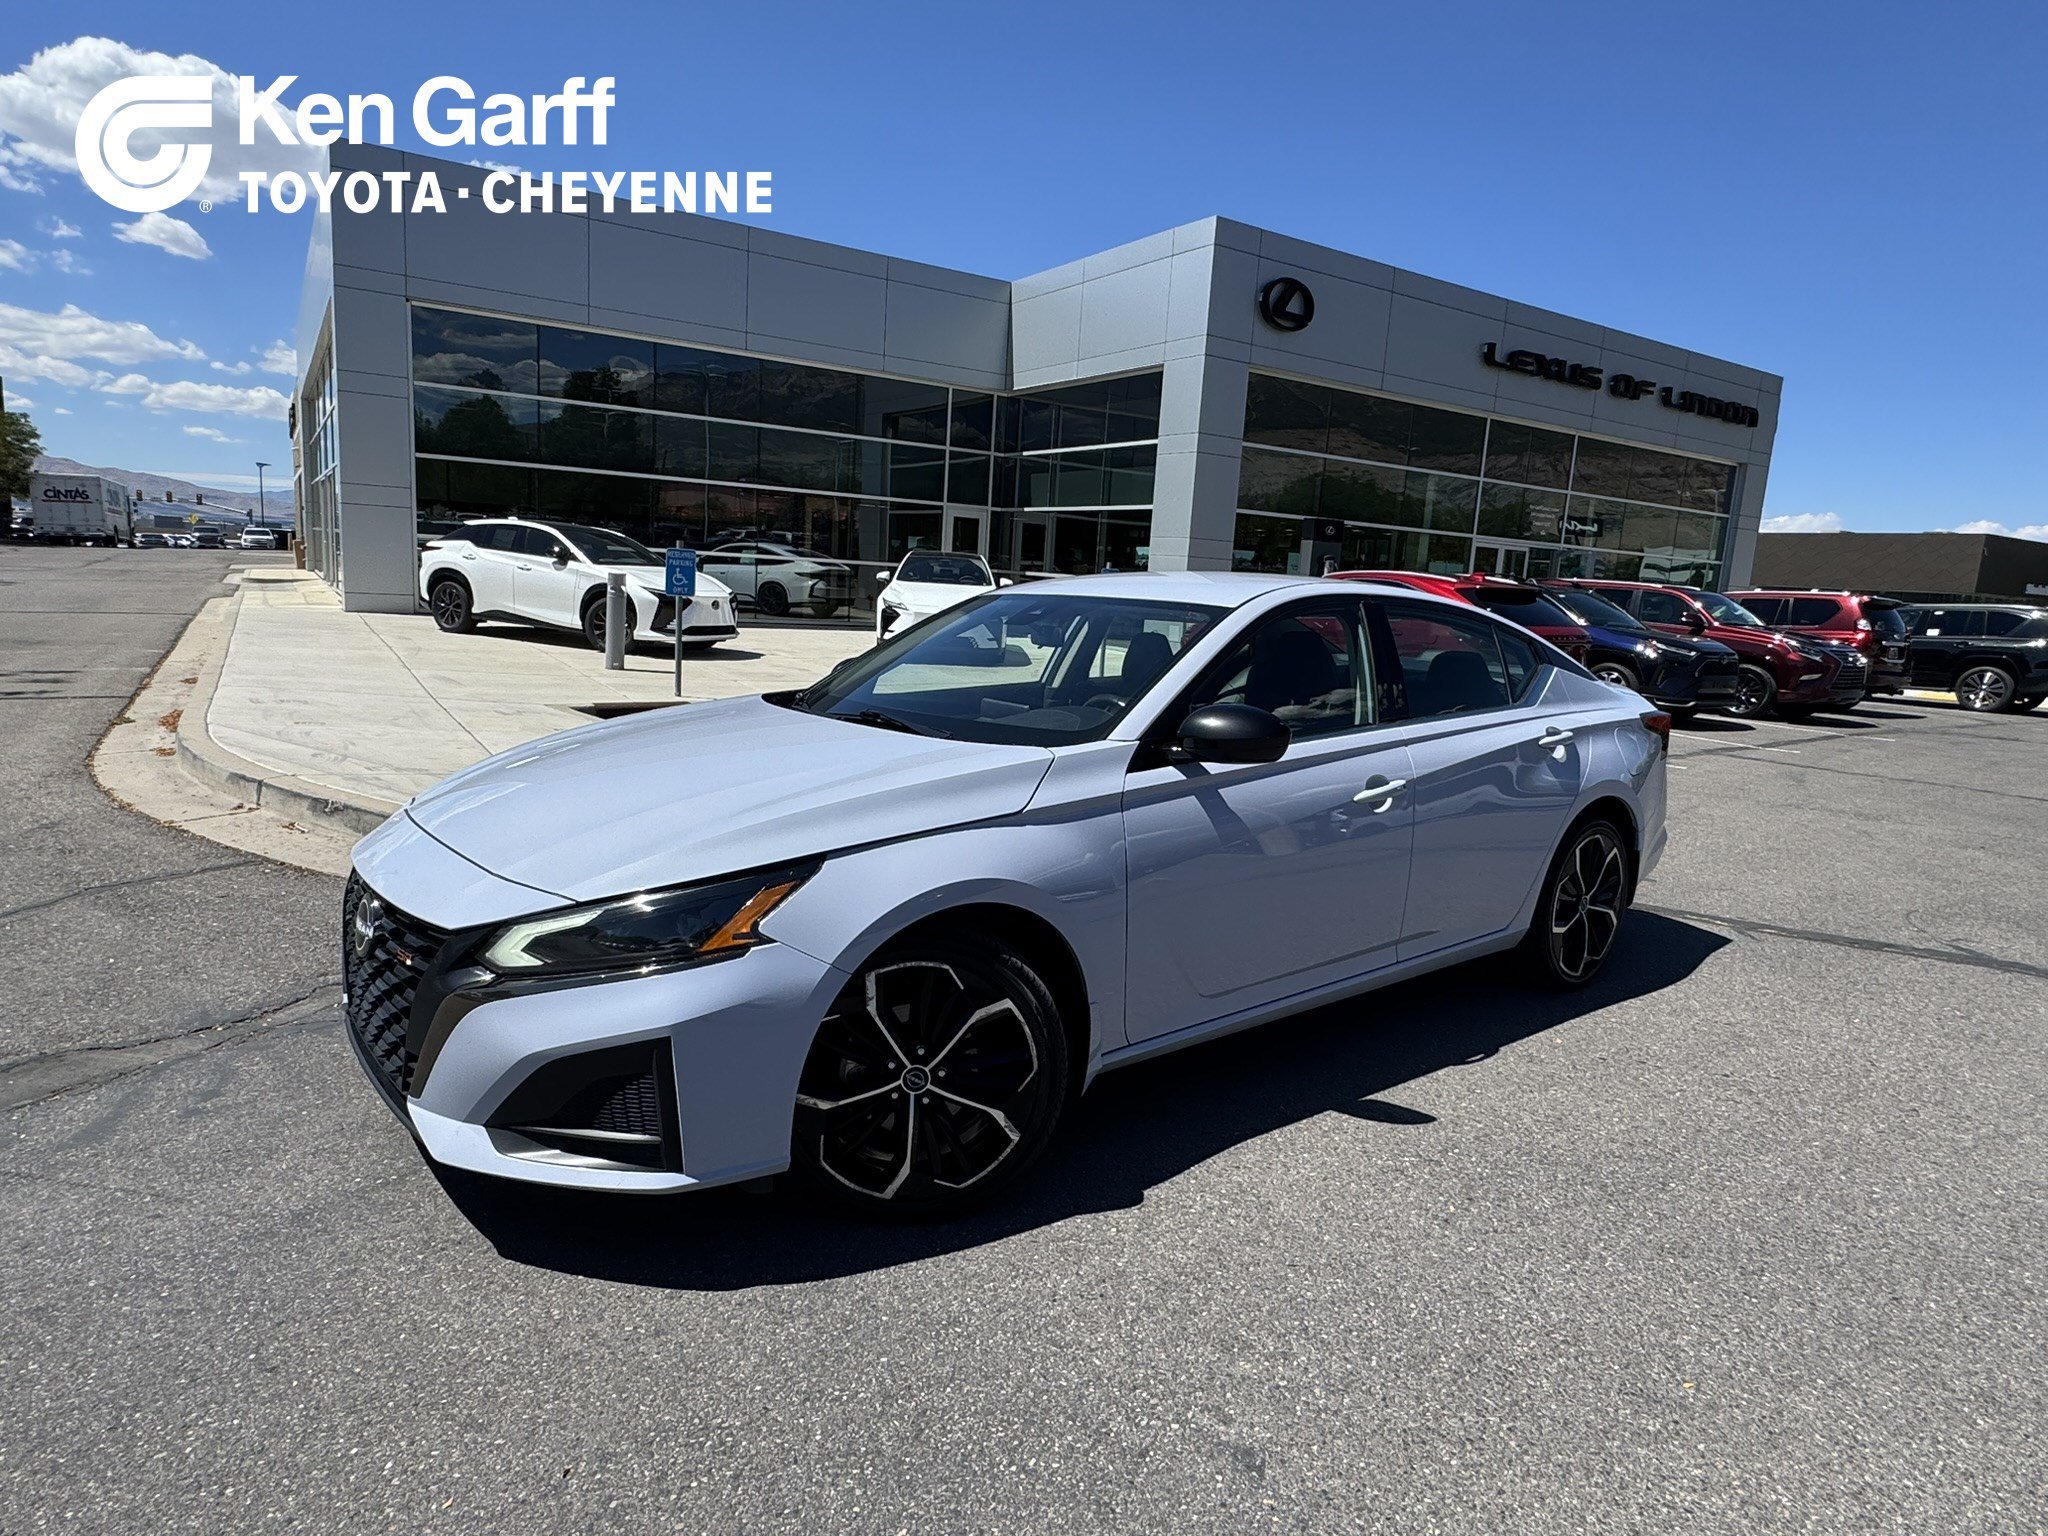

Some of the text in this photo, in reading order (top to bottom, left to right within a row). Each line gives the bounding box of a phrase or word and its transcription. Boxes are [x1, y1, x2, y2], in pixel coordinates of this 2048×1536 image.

[1483, 342, 1759, 428] LEXUS OF LINDON
[668, 551, 695, 559] RESERVED
[668, 558, 694, 567] PARKING
